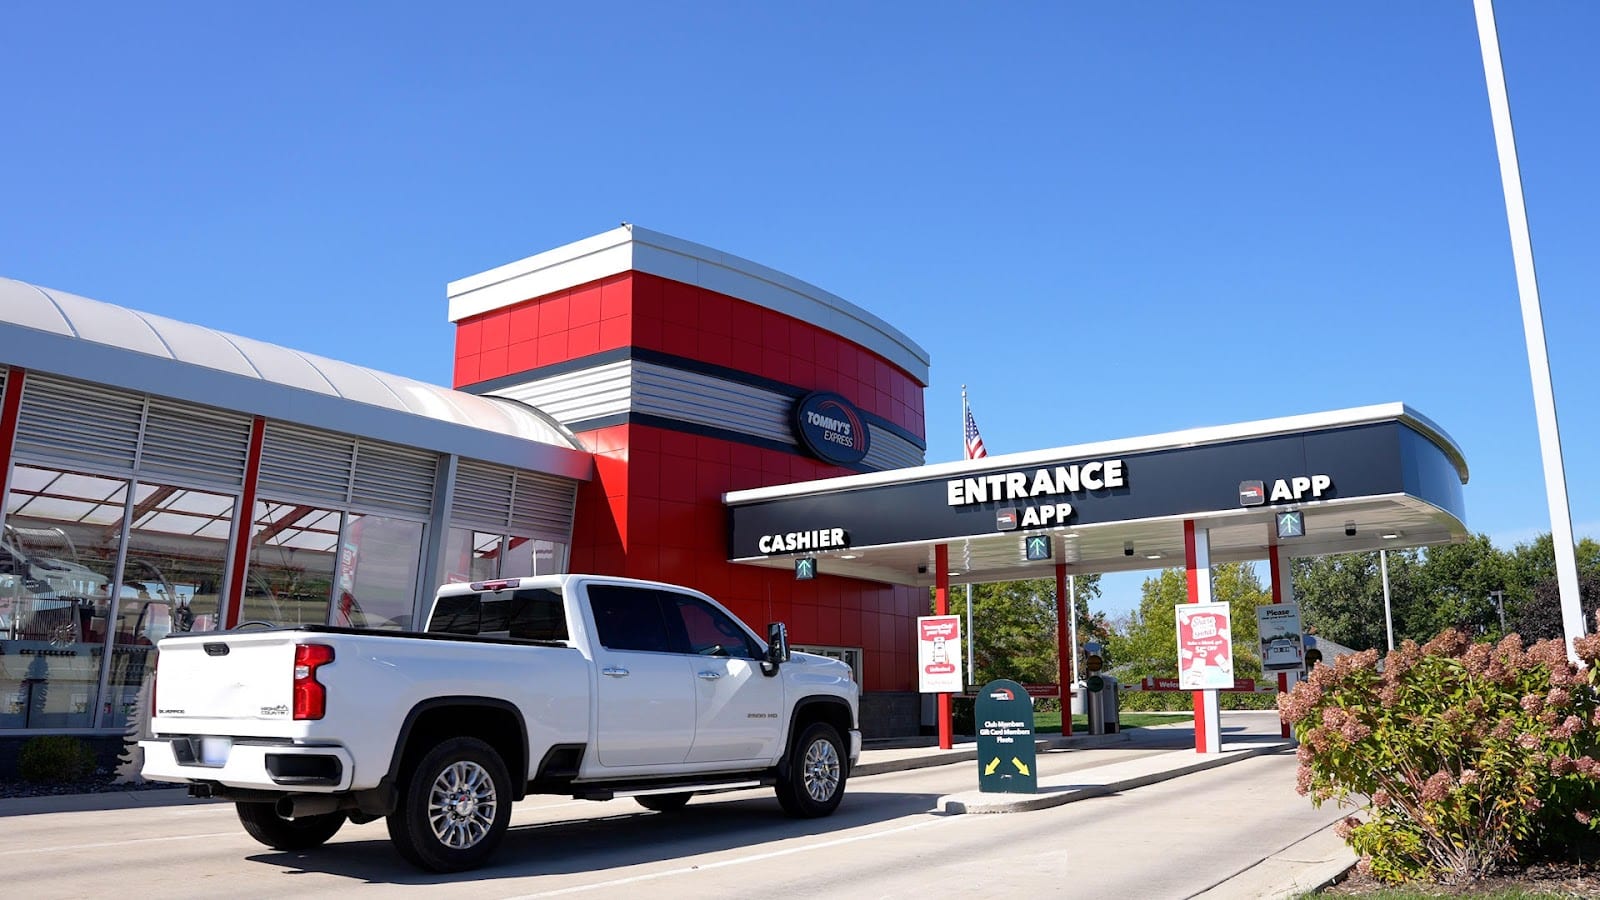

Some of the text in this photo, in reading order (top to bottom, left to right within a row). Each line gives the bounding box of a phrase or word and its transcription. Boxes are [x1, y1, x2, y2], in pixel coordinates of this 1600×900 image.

[807, 411, 851, 435] TOMMY'S
[824, 430, 853, 448] EXPRESS
[947, 459, 1124, 506] ENTRANCE
[1269, 474, 1331, 502] APP
[1021, 502, 1072, 527] APP
[758, 527, 845, 554] CASHIER
[1195, 646, 1208, 657] $5
[998, 720, 1025, 728] Members
[1003, 728, 1031, 736] Members
